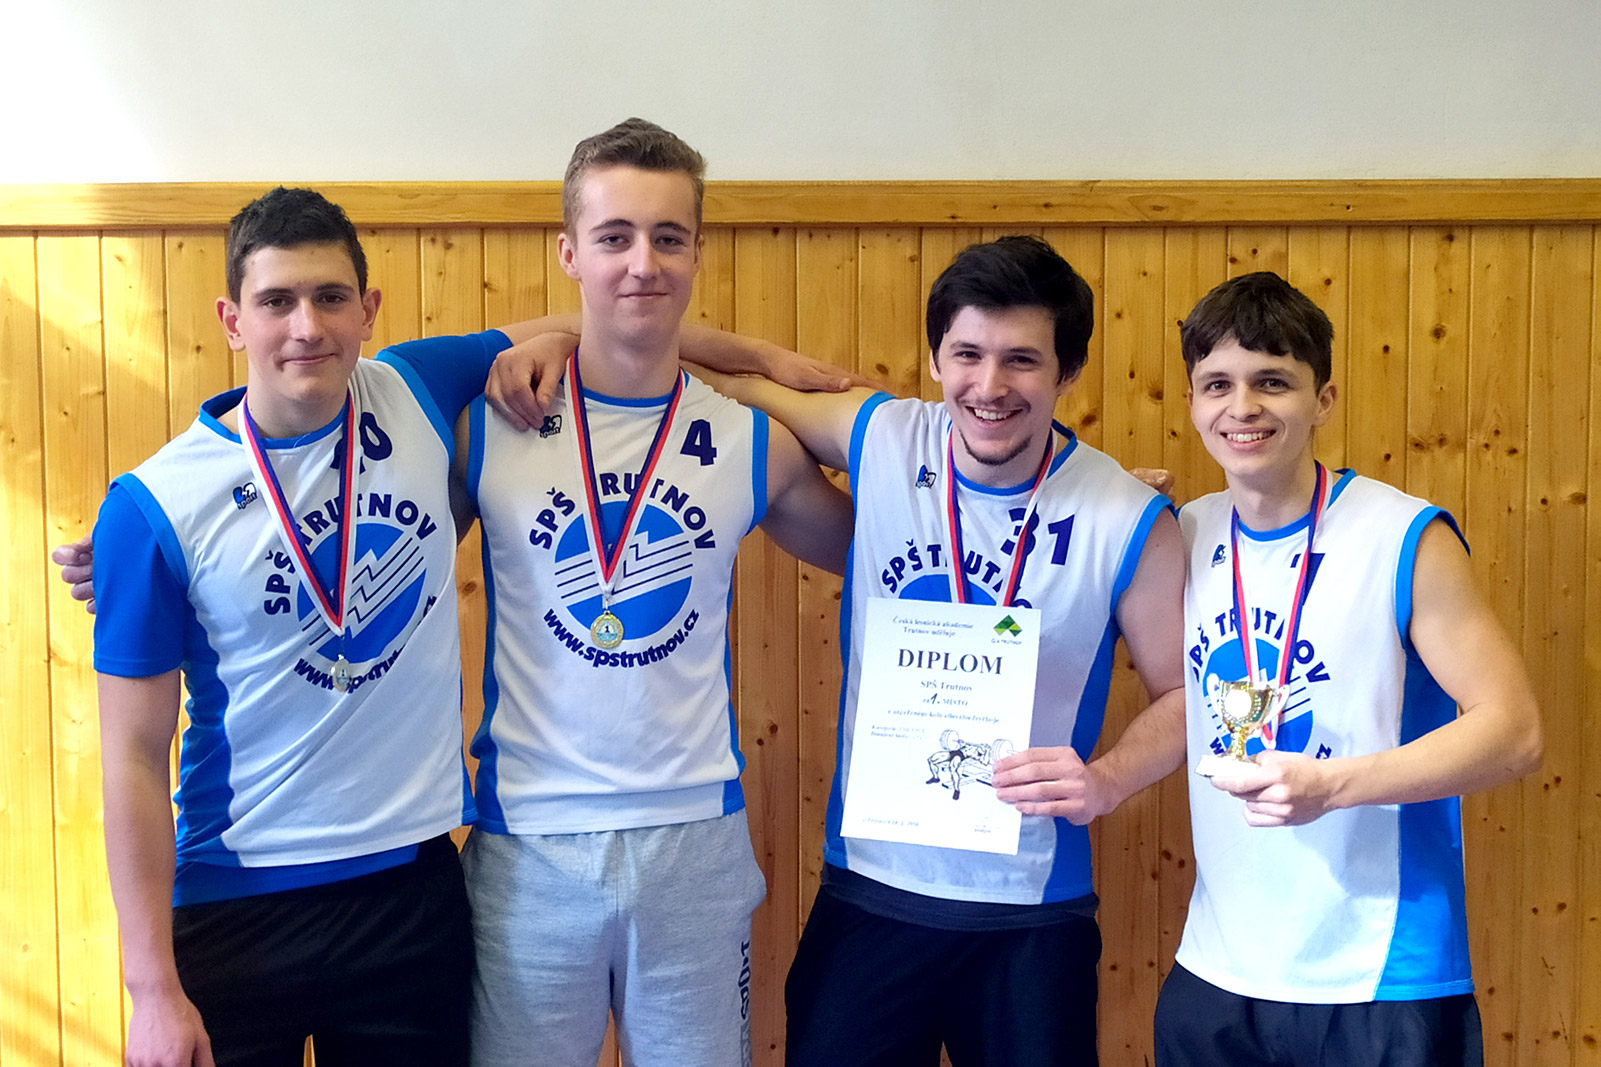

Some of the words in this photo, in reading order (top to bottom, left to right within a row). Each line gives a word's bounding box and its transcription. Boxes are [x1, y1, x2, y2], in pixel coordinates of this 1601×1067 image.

[679, 418, 718, 467] 4
[529, 487, 576, 550] SPŠ
[599, 472, 716, 549] RUTNOV
[1000, 506, 1076, 567] 31
[881, 538, 923, 594] SPŠ
[543, 608, 700, 669] www.spstrutnov.cz
[897, 648, 1003, 675] DIPLOM
[920, 680, 937, 689] SPŠ
